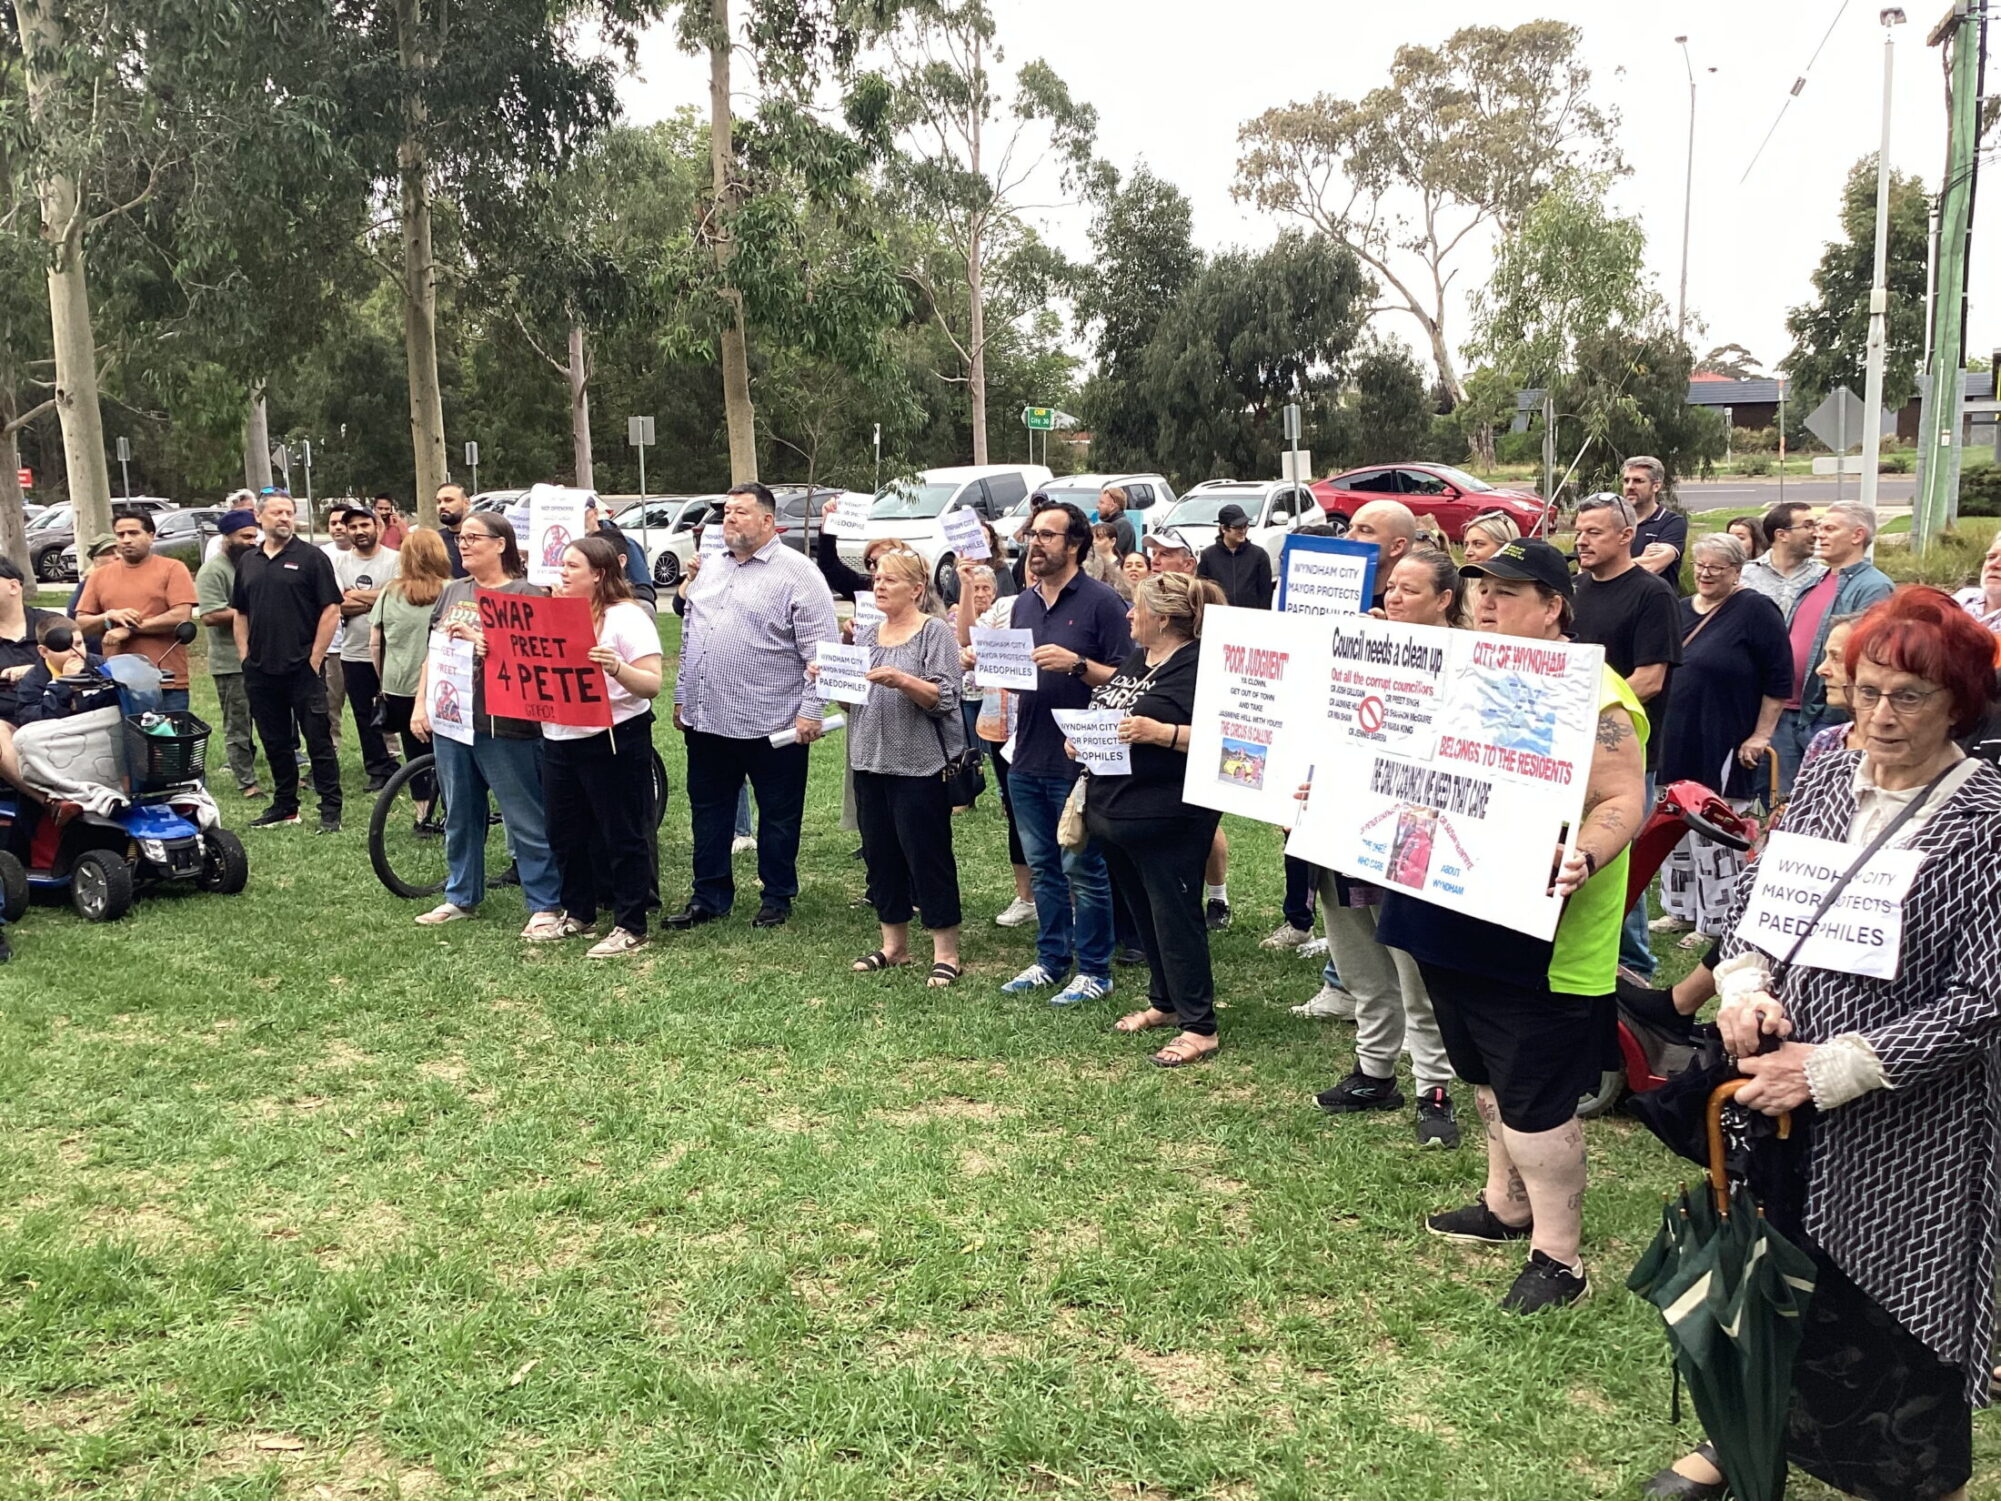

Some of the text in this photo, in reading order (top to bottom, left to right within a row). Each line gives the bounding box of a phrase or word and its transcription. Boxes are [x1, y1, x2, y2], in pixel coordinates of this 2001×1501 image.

[1294, 563, 1359, 579] WYNDHAM CITY
[1288, 582, 1360, 601] MAYOR PROTECTS
[479, 596, 534, 631] SWAP
[510, 634, 566, 658] PREET
[976, 640, 1010, 648] WYNDHAM
[1332, 626, 1442, 680] Council needs a clean up
[1473, 640, 1566, 678] CITY OF WYNDHAM
[979, 664, 1032, 676] PAEDOPHILES
[497, 660, 602, 704] 4 PETE
[820, 678, 866, 692] PAEDOPHILES
[1332, 667, 1342, 681] Out
[1344, 670, 1352, 682] all
[1354, 670, 1364, 685] the
[1366, 676, 1392, 692] corrupt
[1260, 692, 1275, 702] TOWN
[1250, 703, 1264, 712] TAKE
[1240, 713, 1250, 722] HILL
[1252, 716, 1266, 724] WITH
[1099, 724, 1118, 732] CITY
[1082, 752, 1124, 760] OPHILES
[1439, 736, 1573, 785] BELONGS TO THE RESIDENTS
[1468, 779, 1492, 819] CARE
[1370, 860, 1384, 872] CARE
[1441, 865, 1460, 877] ABOUT
[1778, 858, 1896, 886] WYNDH CITY
[1433, 880, 1464, 895] WYNDHAM
[1762, 884, 1892, 914] MAYOR OTECTS
